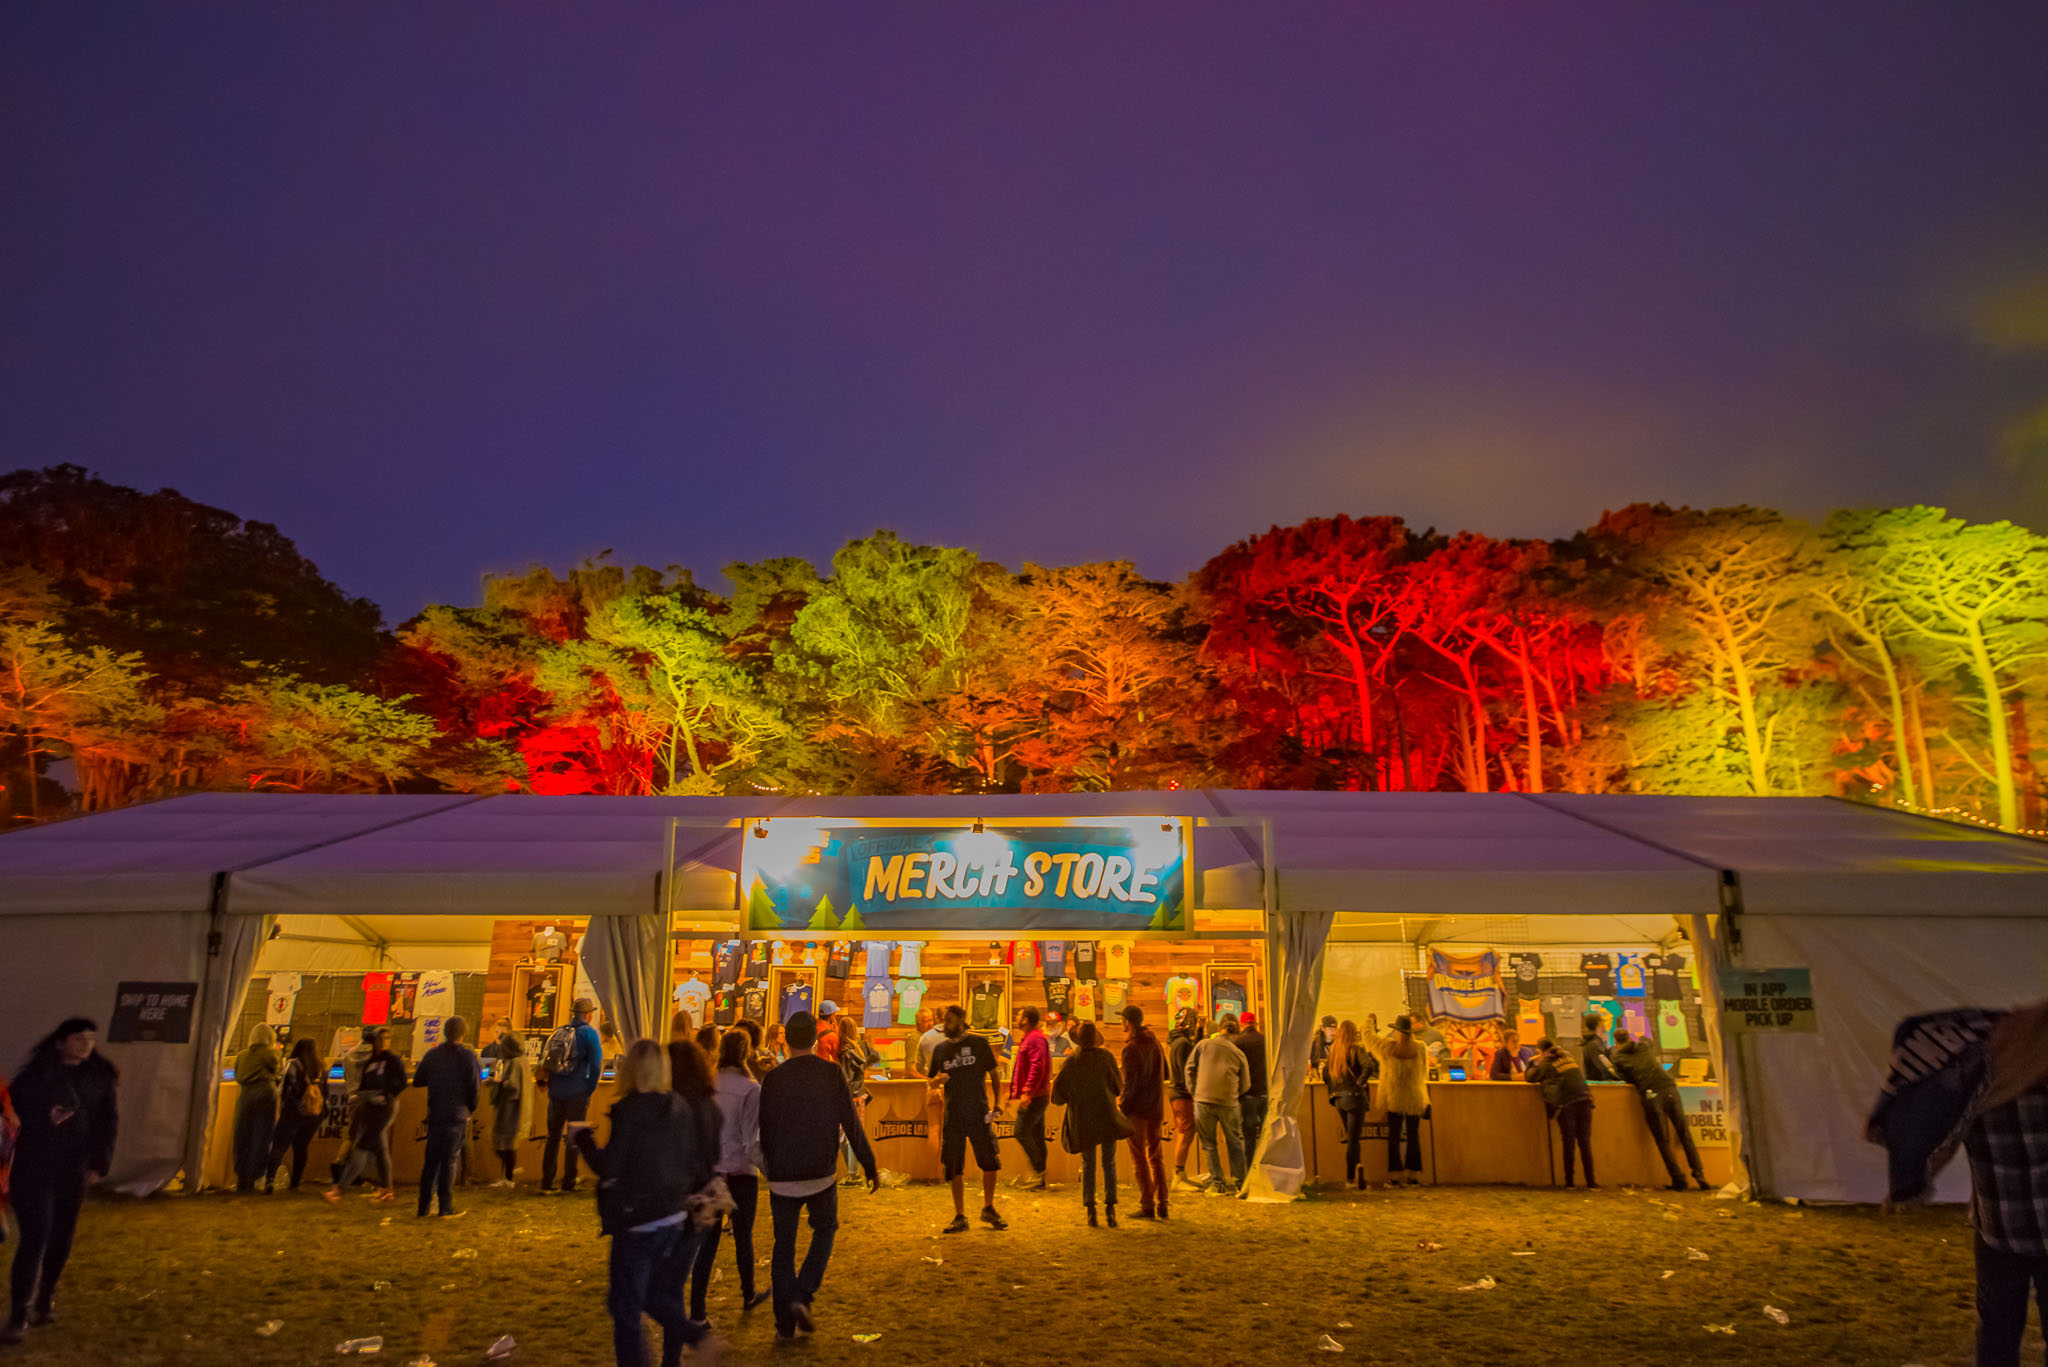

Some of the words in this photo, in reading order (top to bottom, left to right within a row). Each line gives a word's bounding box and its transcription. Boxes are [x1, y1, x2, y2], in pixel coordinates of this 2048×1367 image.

[856, 837, 921, 857] OFFICIAL
[863, 851, 1018, 902] MERCH
[1023, 850, 1163, 903] STORE
[1761, 982, 1787, 996] APP
[1724, 997, 1769, 1012] MOBILE
[1770, 996, 1814, 1011] ORDER
[1745, 1012, 1773, 1026] PICK
[1775, 1012, 1793, 1026] UP
[1700, 1100, 1713, 1112] IN
[872, 1122, 913, 1139] OUTSIDE
[1701, 1128, 1728, 1141] PICK
